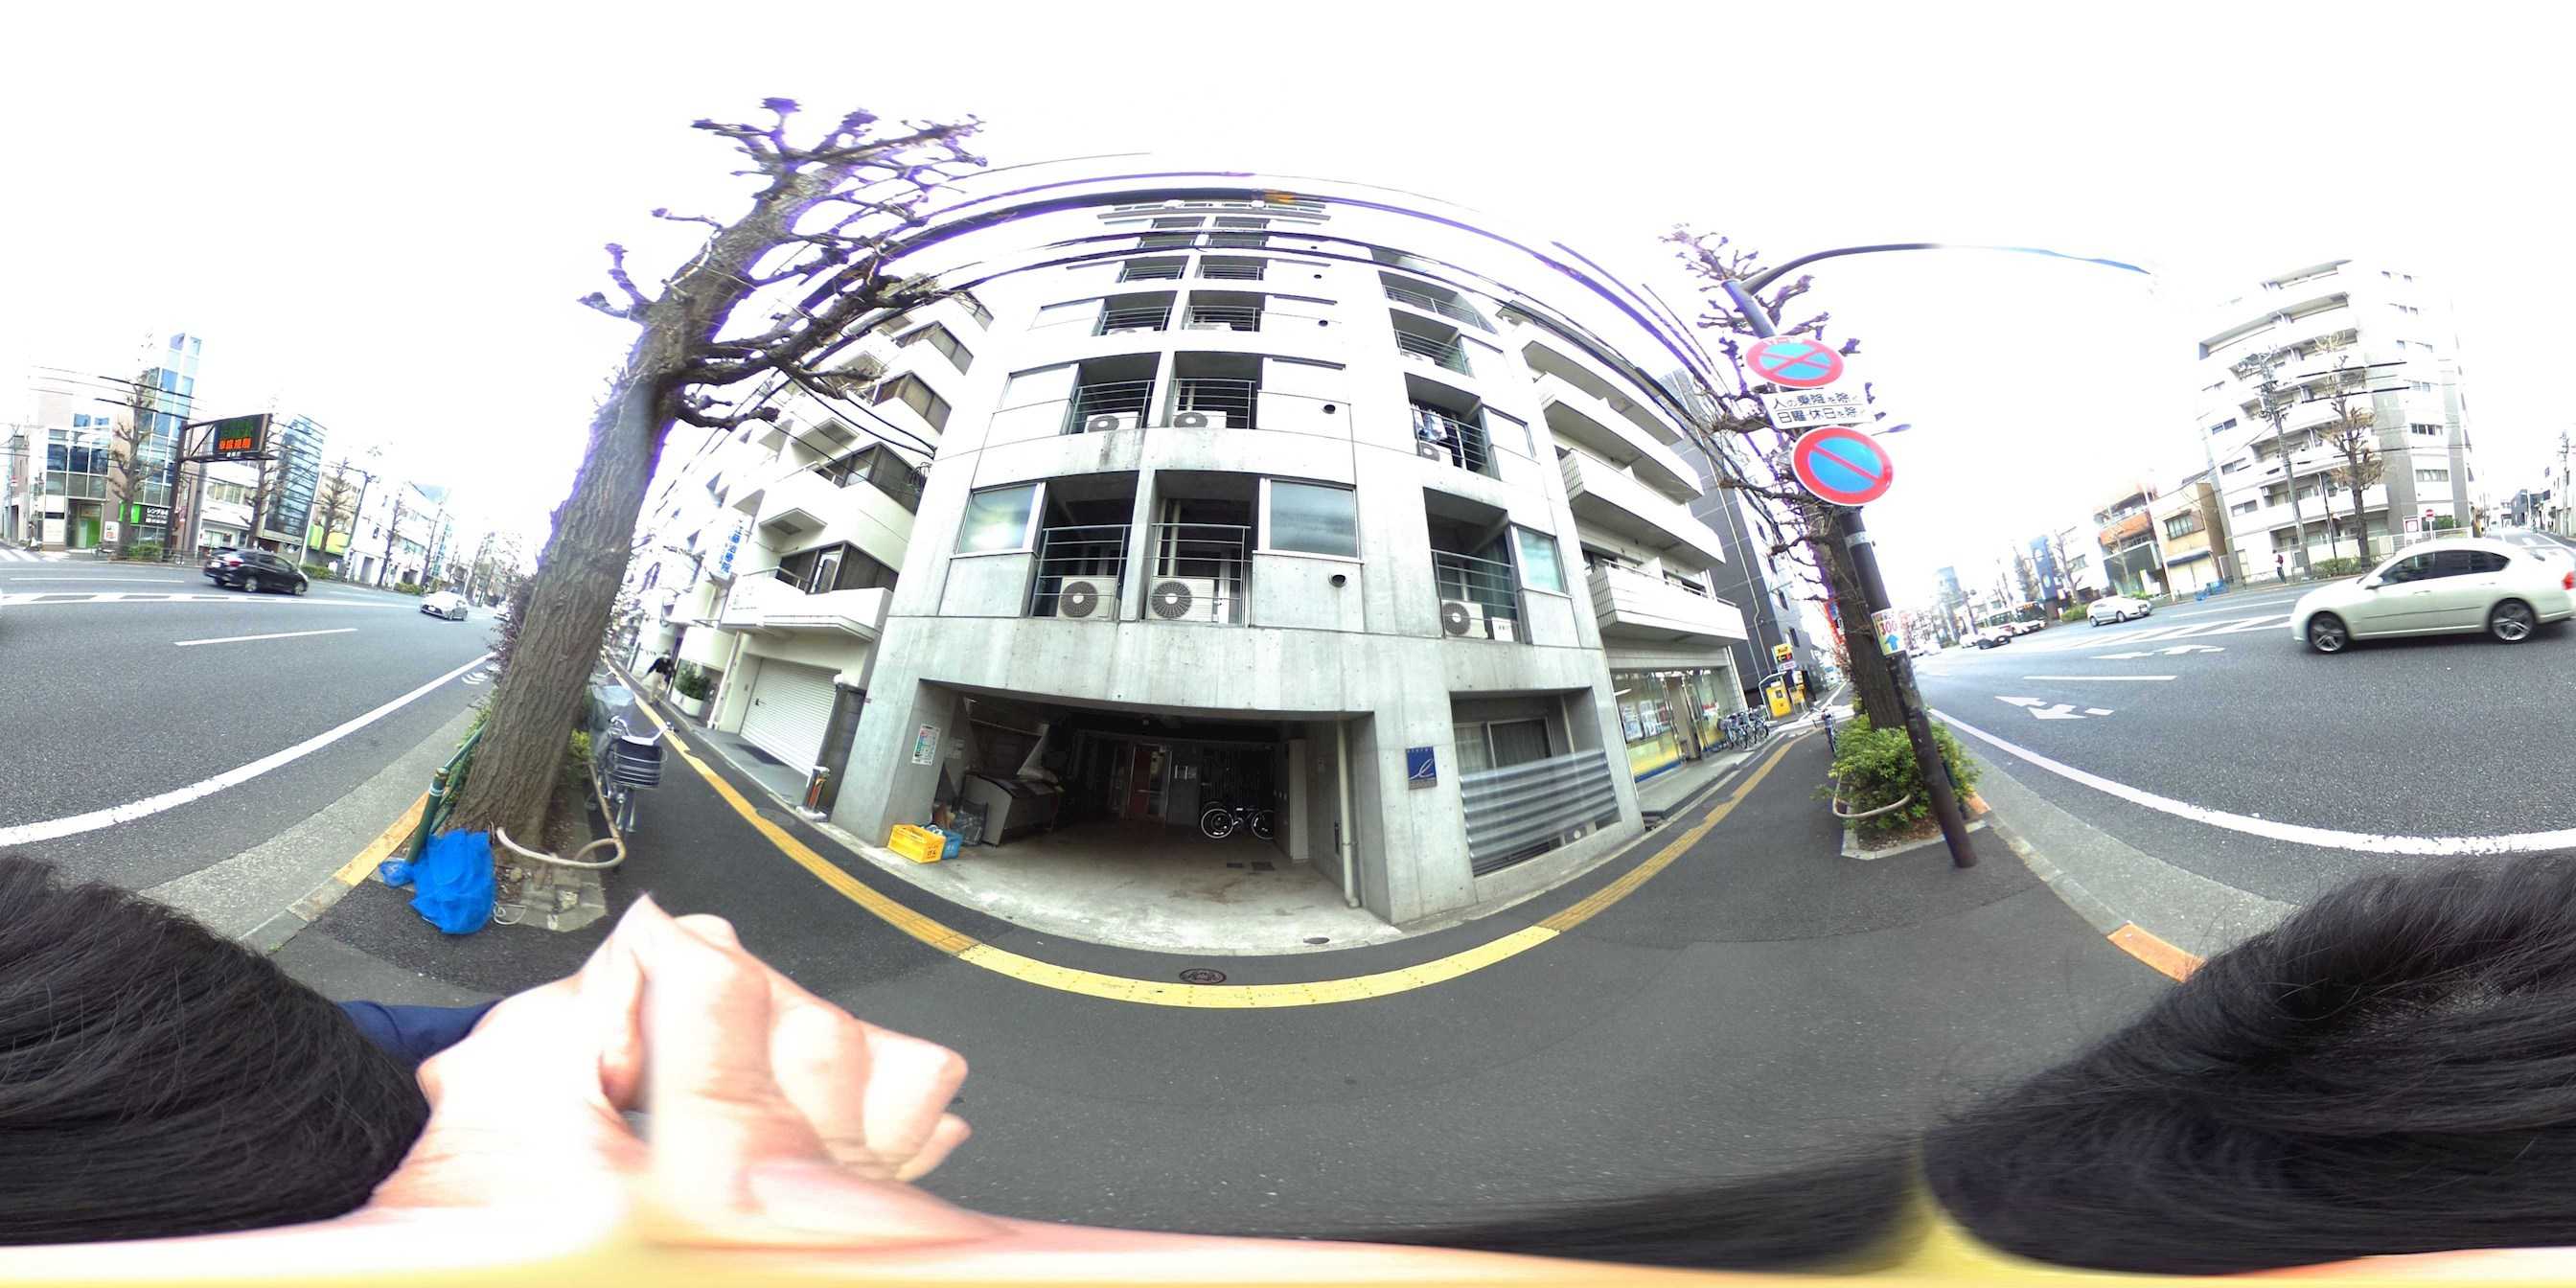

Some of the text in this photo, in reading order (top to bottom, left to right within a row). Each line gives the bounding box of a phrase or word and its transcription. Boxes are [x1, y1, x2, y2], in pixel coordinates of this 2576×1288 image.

[1773, 392, 1859, 410] 人の乗降を除く
